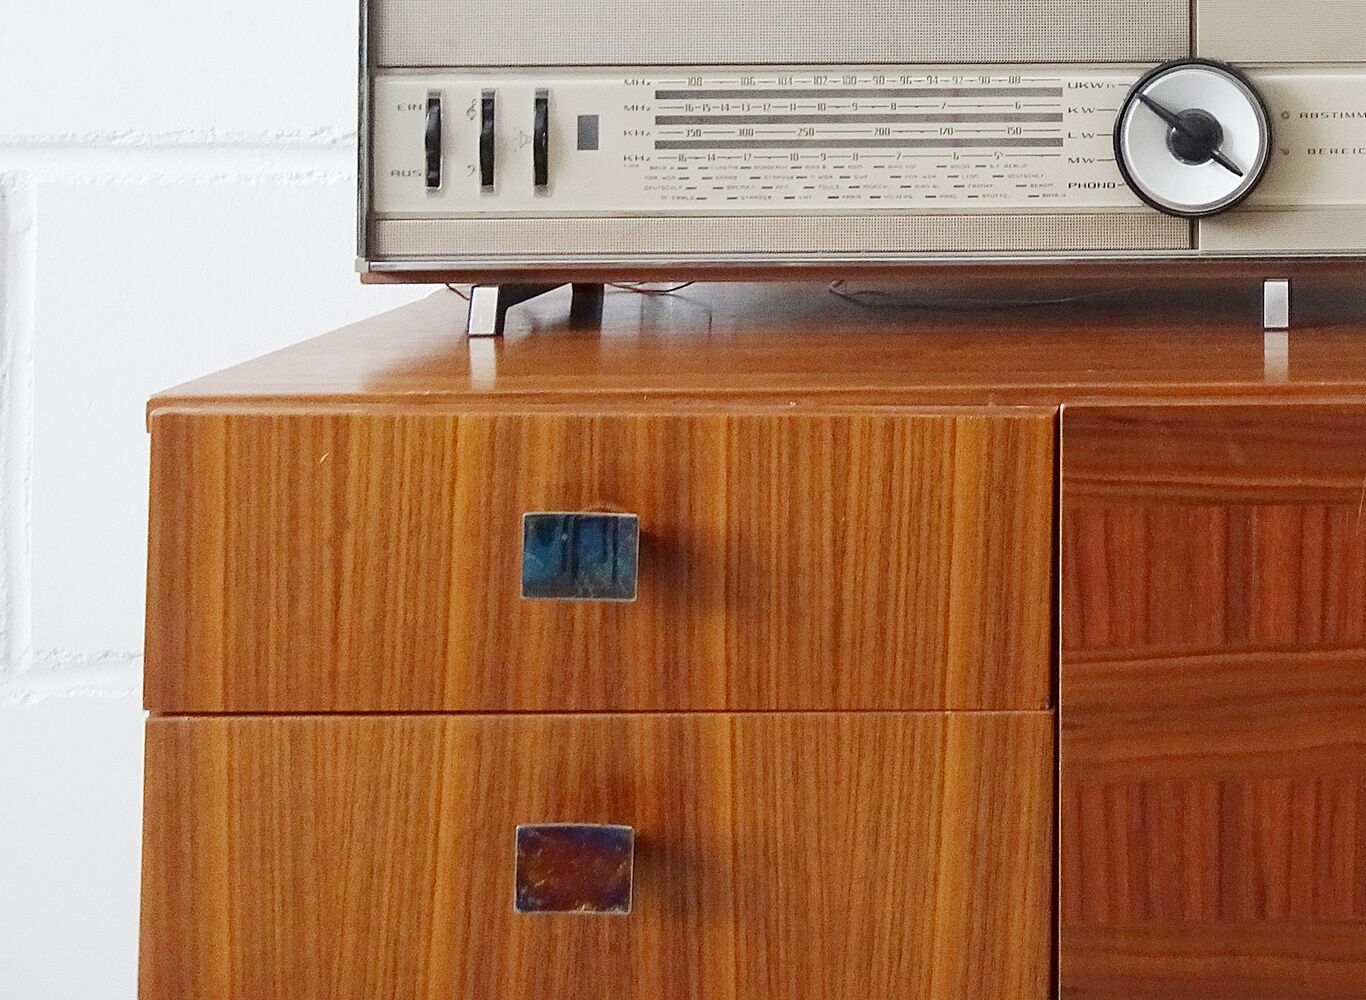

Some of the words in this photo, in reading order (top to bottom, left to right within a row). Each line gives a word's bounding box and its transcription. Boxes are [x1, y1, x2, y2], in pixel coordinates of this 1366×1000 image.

[740, 77, 756, 87] 106
[777, 77, 793, 86] 104
[813, 76, 828, 85] 102
[900, 75, 912, 85] 96
[926, 75, 939, 85] 94
[952, 75, 964, 85] 92
[817, 103, 826, 111] 10
[685, 128, 701, 137] 350
[798, 128, 815, 137] 250
[874, 127, 891, 136] 200
[1007, 127, 1022, 135] 150
[790, 153, 799, 161] 10
